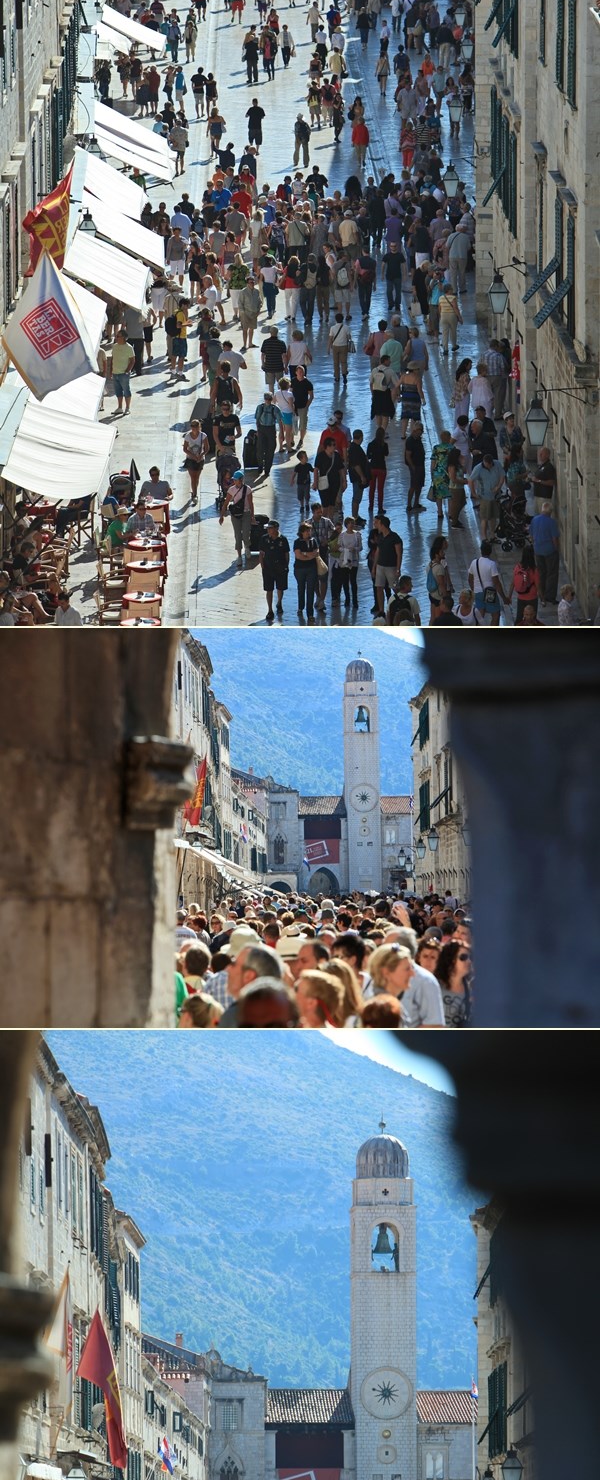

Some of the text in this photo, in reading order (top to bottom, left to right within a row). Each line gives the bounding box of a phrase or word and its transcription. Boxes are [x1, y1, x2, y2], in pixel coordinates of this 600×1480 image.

[44, 308, 56, 320] LI
[29, 318, 46, 338] TAS
[36, 314, 55, 336] BER
